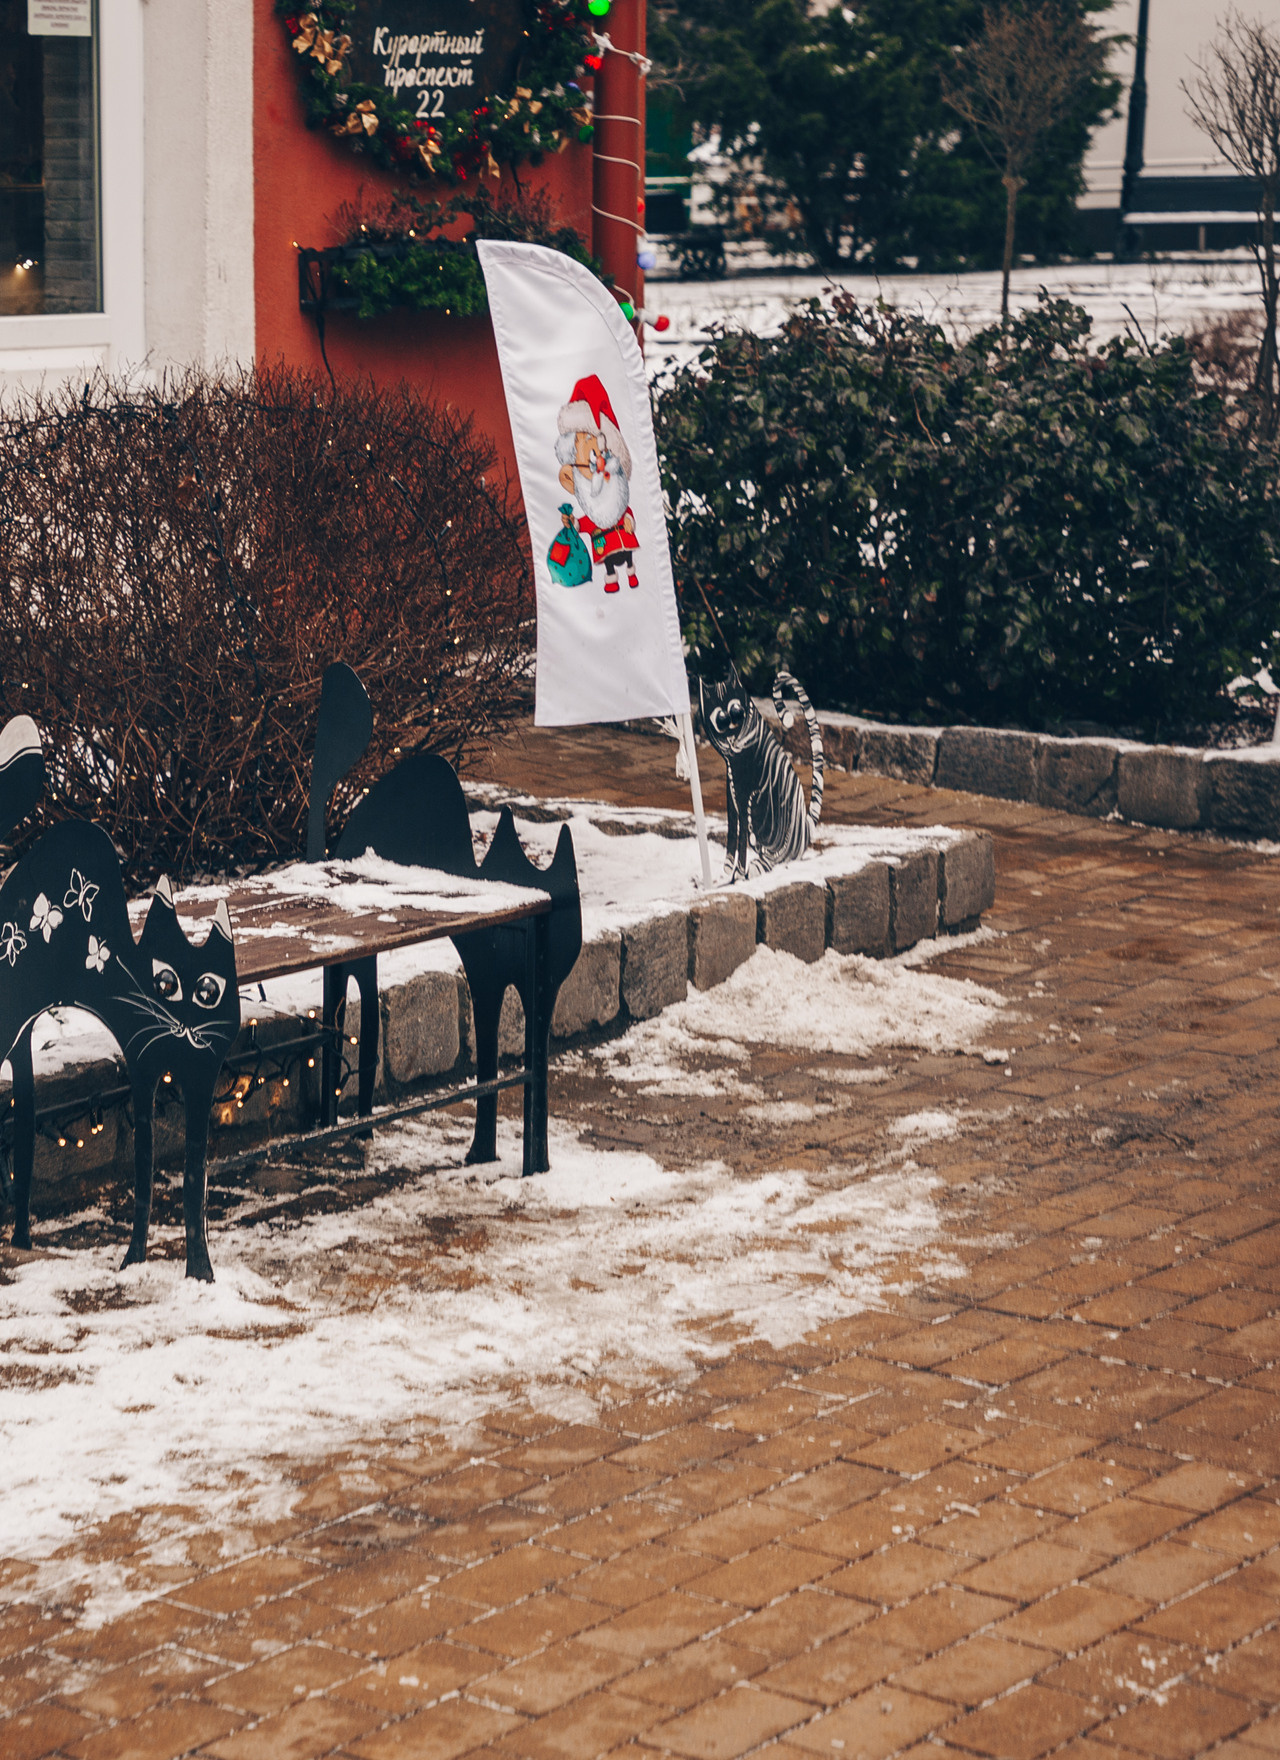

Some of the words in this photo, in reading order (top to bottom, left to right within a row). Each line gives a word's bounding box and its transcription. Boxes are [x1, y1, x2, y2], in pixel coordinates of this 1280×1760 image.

[373, 26, 485, 68] Курортный
[382, 59, 474, 98] проспект
[415, 89, 445, 118] 22
